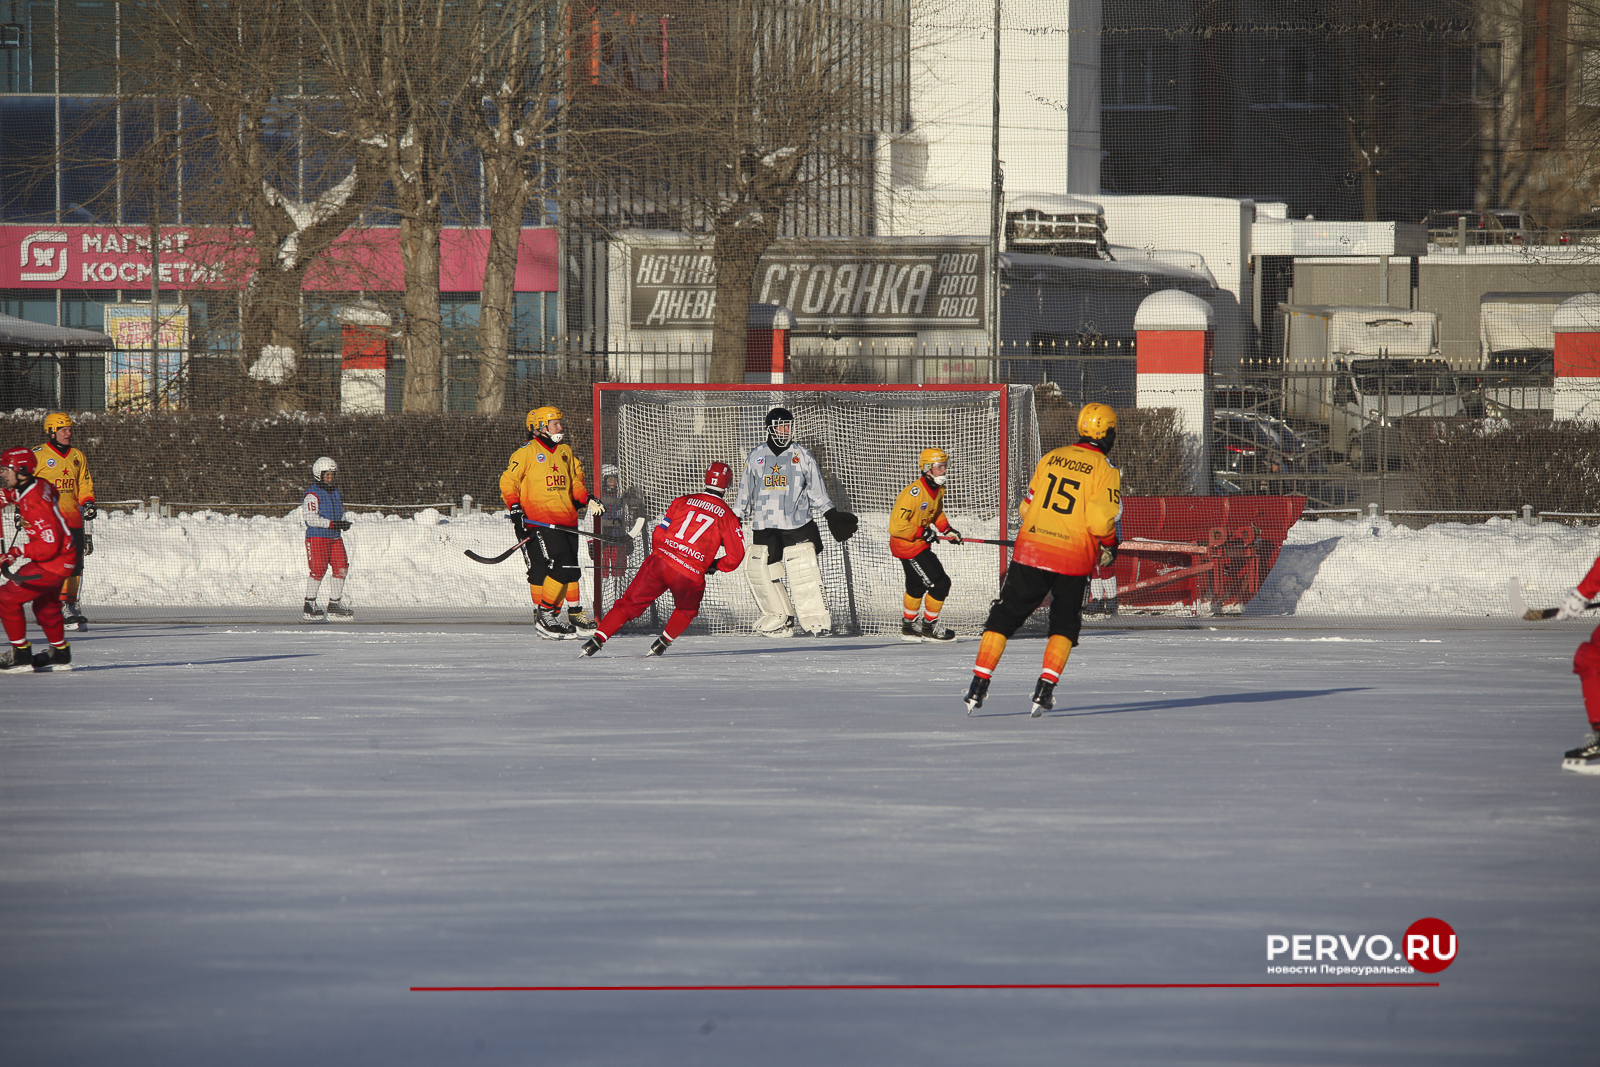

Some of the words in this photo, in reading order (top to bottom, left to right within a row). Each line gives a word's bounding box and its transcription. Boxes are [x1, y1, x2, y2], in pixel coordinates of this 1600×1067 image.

[82, 233, 189, 253] МАГНИТ
[82, 262, 228, 282] КОСМЕТИК
[636, 254, 717, 284] НОЧНА
[938, 253, 979, 273] АВТО
[758, 263, 933, 314] СТОЯНКА
[937, 275, 979, 296] АВТО
[937, 296, 979, 317] АВТО
[1046, 455, 1093, 474] ДЖУСОЕВ
[55, 478, 75, 489] СКА
[546, 475, 566, 487] СКА
[764, 475, 787, 487] СКА
[1041, 472, 1081, 515] 15
[686, 498, 726, 518] ВШИВКОВ
[674, 510, 715, 545] 17
